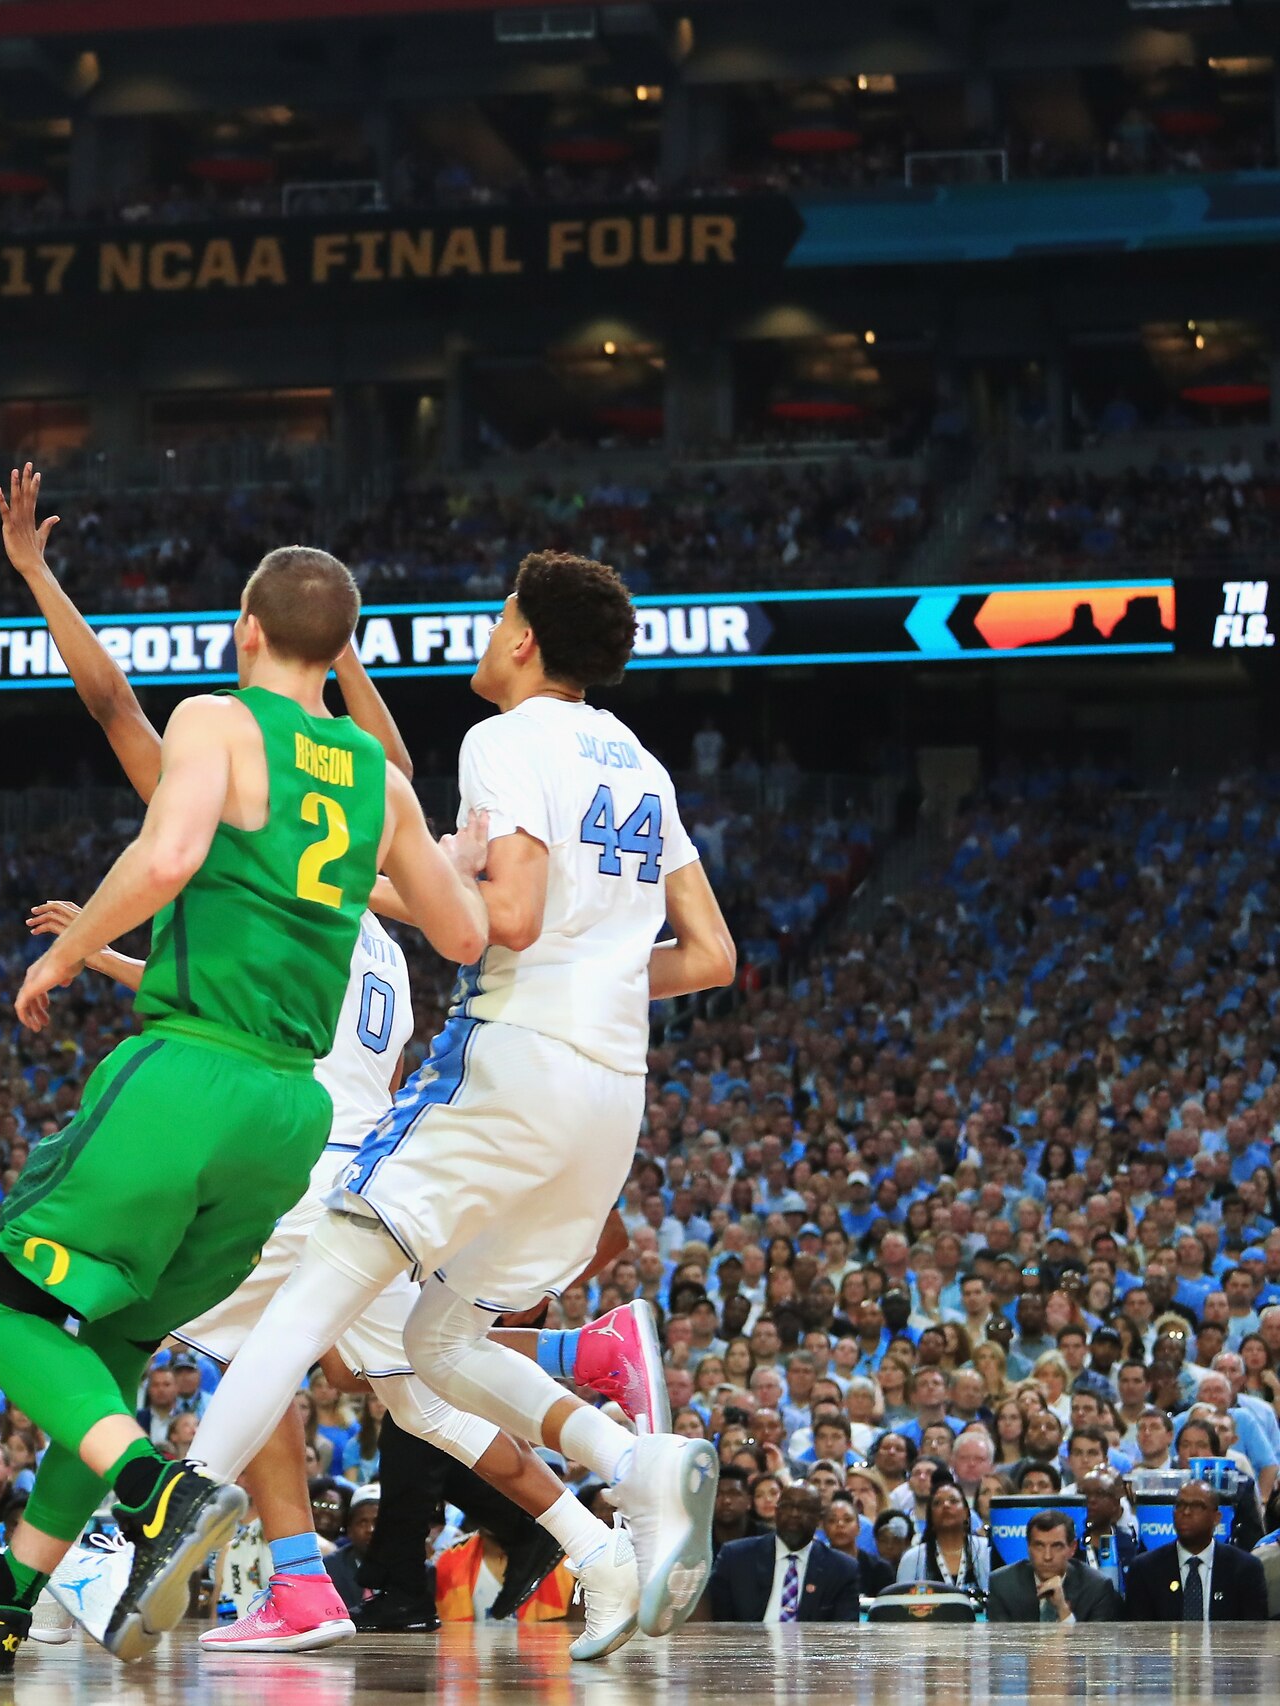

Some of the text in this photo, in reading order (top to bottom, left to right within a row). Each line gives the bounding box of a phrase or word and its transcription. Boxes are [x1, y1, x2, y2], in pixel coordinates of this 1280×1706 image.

[98, 237, 287, 291] NCAA
[313, 226, 523, 282] FINAL
[548, 215, 737, 270] FOUR
[1222, 581, 1269, 614] TM
[97, 624, 233, 672] 2017
[631, 606, 750, 655] OUR
[295, 732, 354, 787] BENSON
[296, 791, 350, 909] 2
[580, 784, 664, 884] 44
[356, 971, 396, 1054] 0
